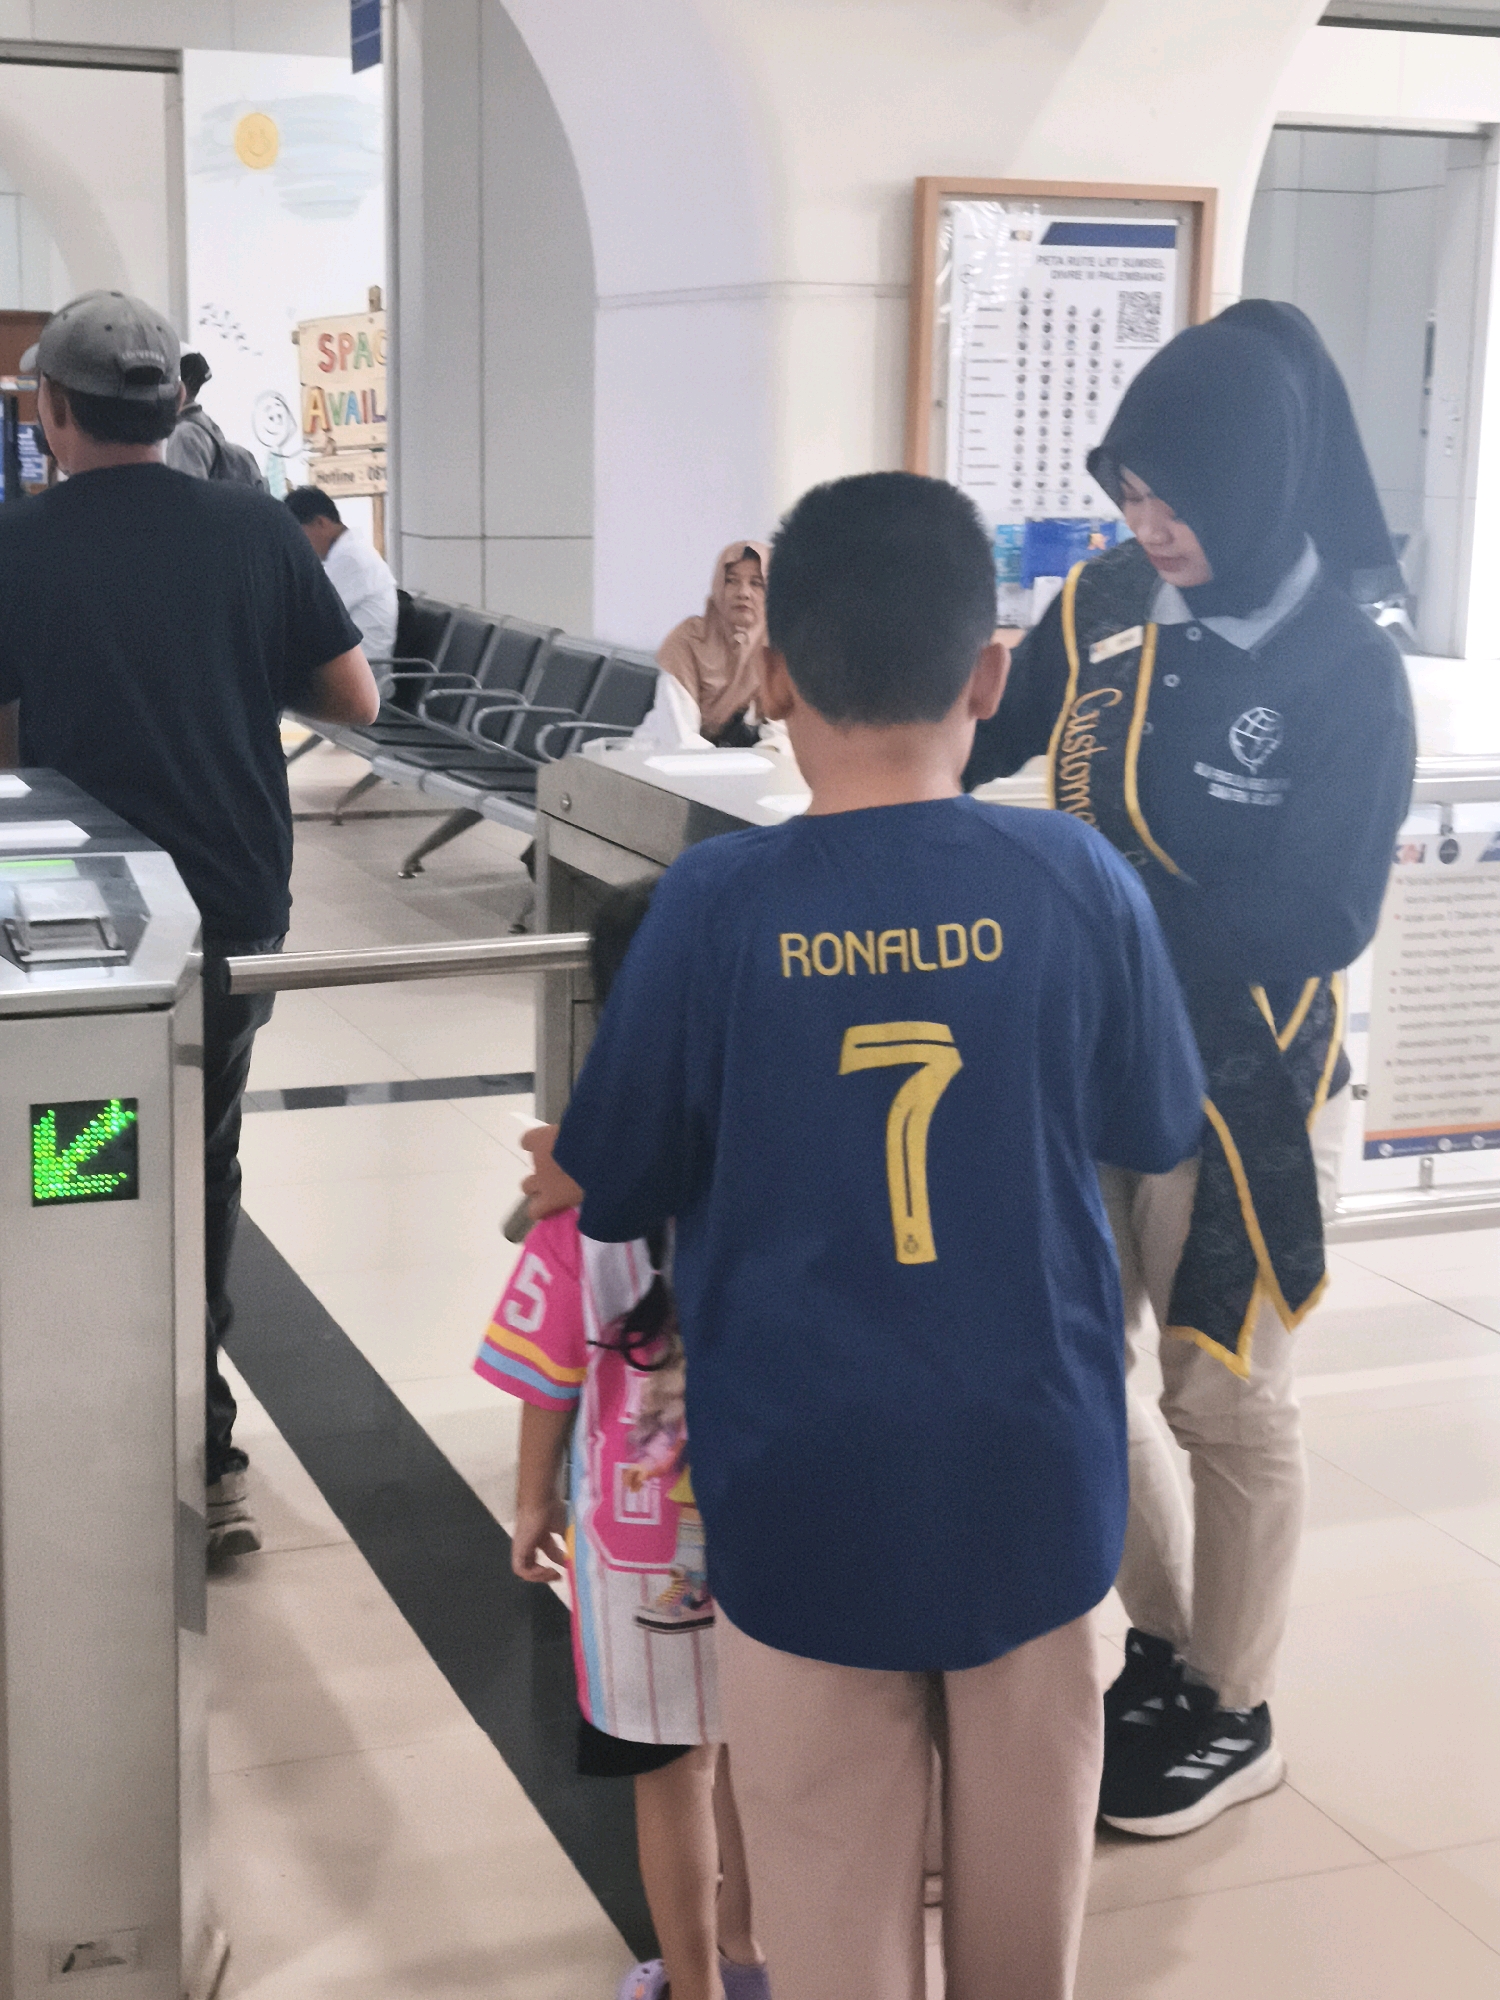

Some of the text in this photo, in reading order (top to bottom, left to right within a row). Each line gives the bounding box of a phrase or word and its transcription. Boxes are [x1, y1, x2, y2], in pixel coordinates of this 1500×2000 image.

[779, 918, 1003, 978] RONALDO
[838, 1020, 963, 1265] 7
[504, 1252, 553, 1333] 5
